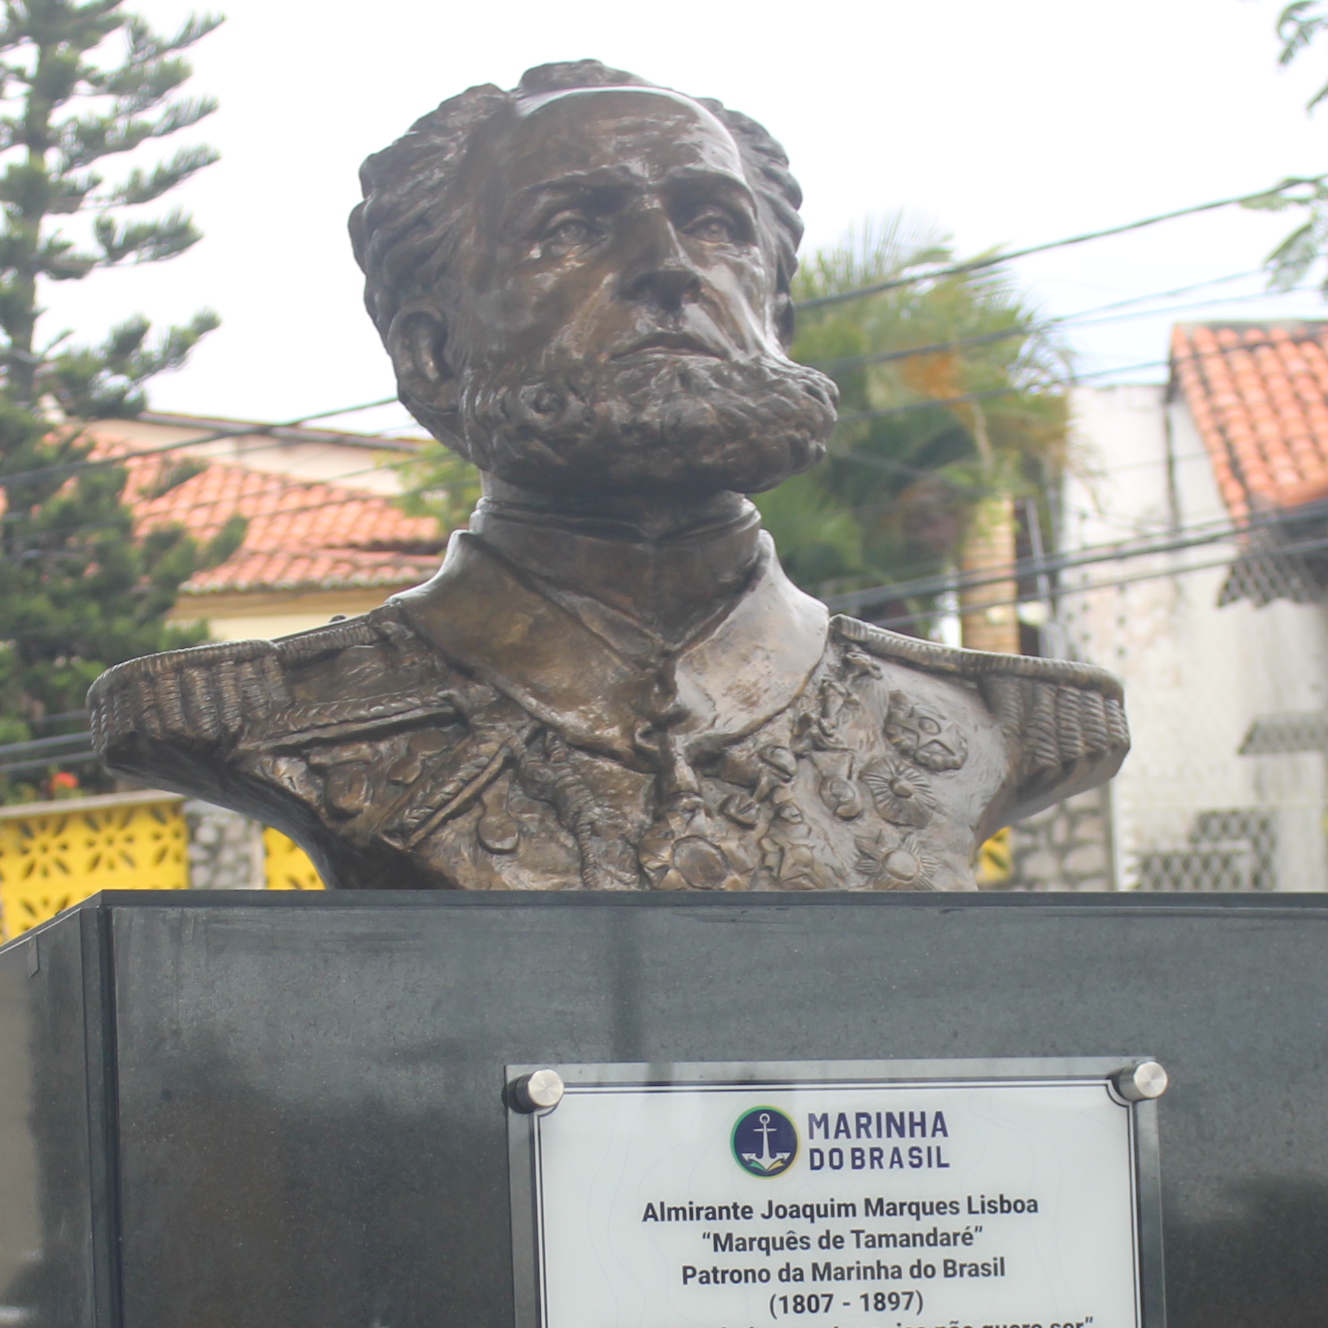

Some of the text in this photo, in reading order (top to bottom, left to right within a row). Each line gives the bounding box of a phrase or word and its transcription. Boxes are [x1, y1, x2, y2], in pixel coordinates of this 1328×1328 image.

[807, 1110, 949, 1140] MARINHA
[641, 1193, 1039, 1224] Almirante Joaquim Marques Lisboa
[817, 1229, 846, 1251] de
[681, 1256, 1006, 1286] Patrono da Marinha do Brasil
[769, 1293, 835, 1320] (1807
[859, 1290, 924, 1316] 1897)
